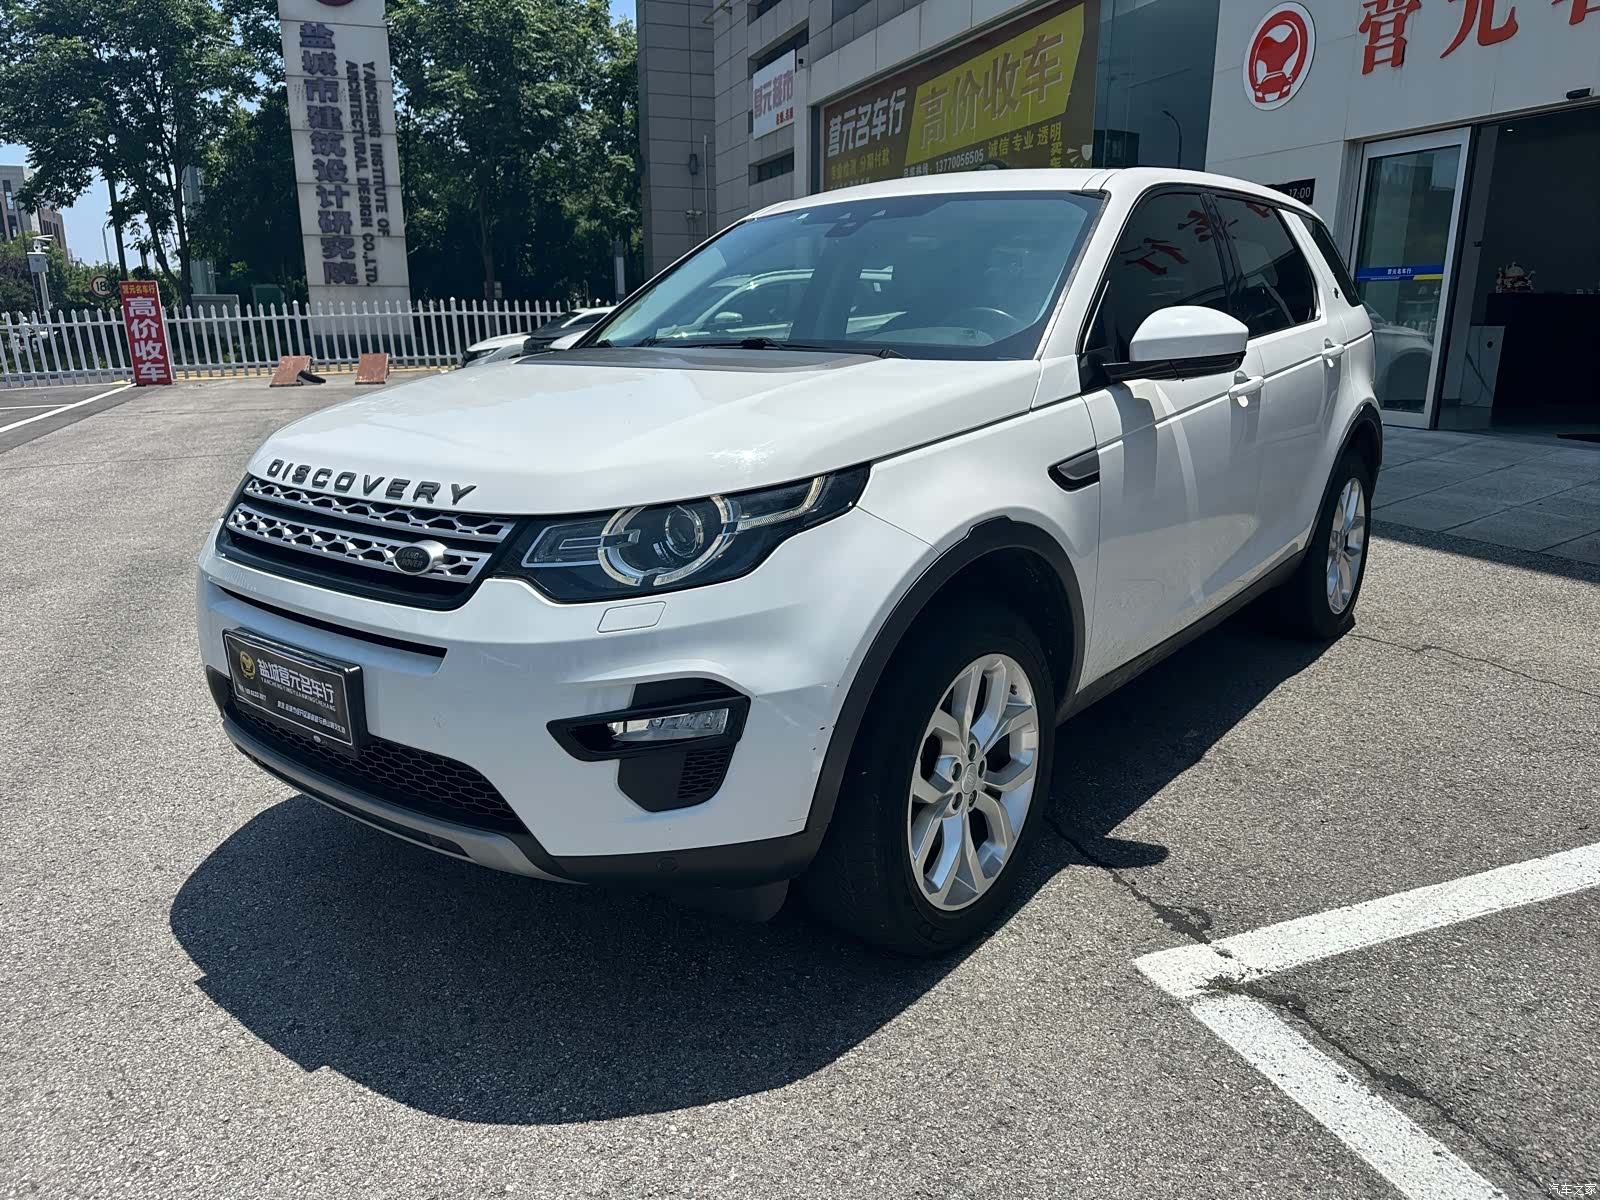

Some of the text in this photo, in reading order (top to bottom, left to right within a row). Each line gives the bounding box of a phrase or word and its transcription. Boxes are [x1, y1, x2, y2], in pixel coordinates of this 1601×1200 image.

[827, 86, 907, 158] 营元名车行
[919, 33, 1065, 150] 高价收车
[299, 22, 358, 285] 盐城市建筑设计研究院
[345, 60, 369, 173] ARCHITECTURAL
[357, 177, 373, 228] DESIGN
[362, 61, 391, 238] YANCHENG INSTITUTE OF
[935, 149, 984, 173] 13770056505
[1012, 130, 1035, 151] 专业
[125, 296, 167, 382] 高价收车
[266, 458, 477, 506] DISCOVERY
[257, 658, 334, 704] 盐城营元名车行
